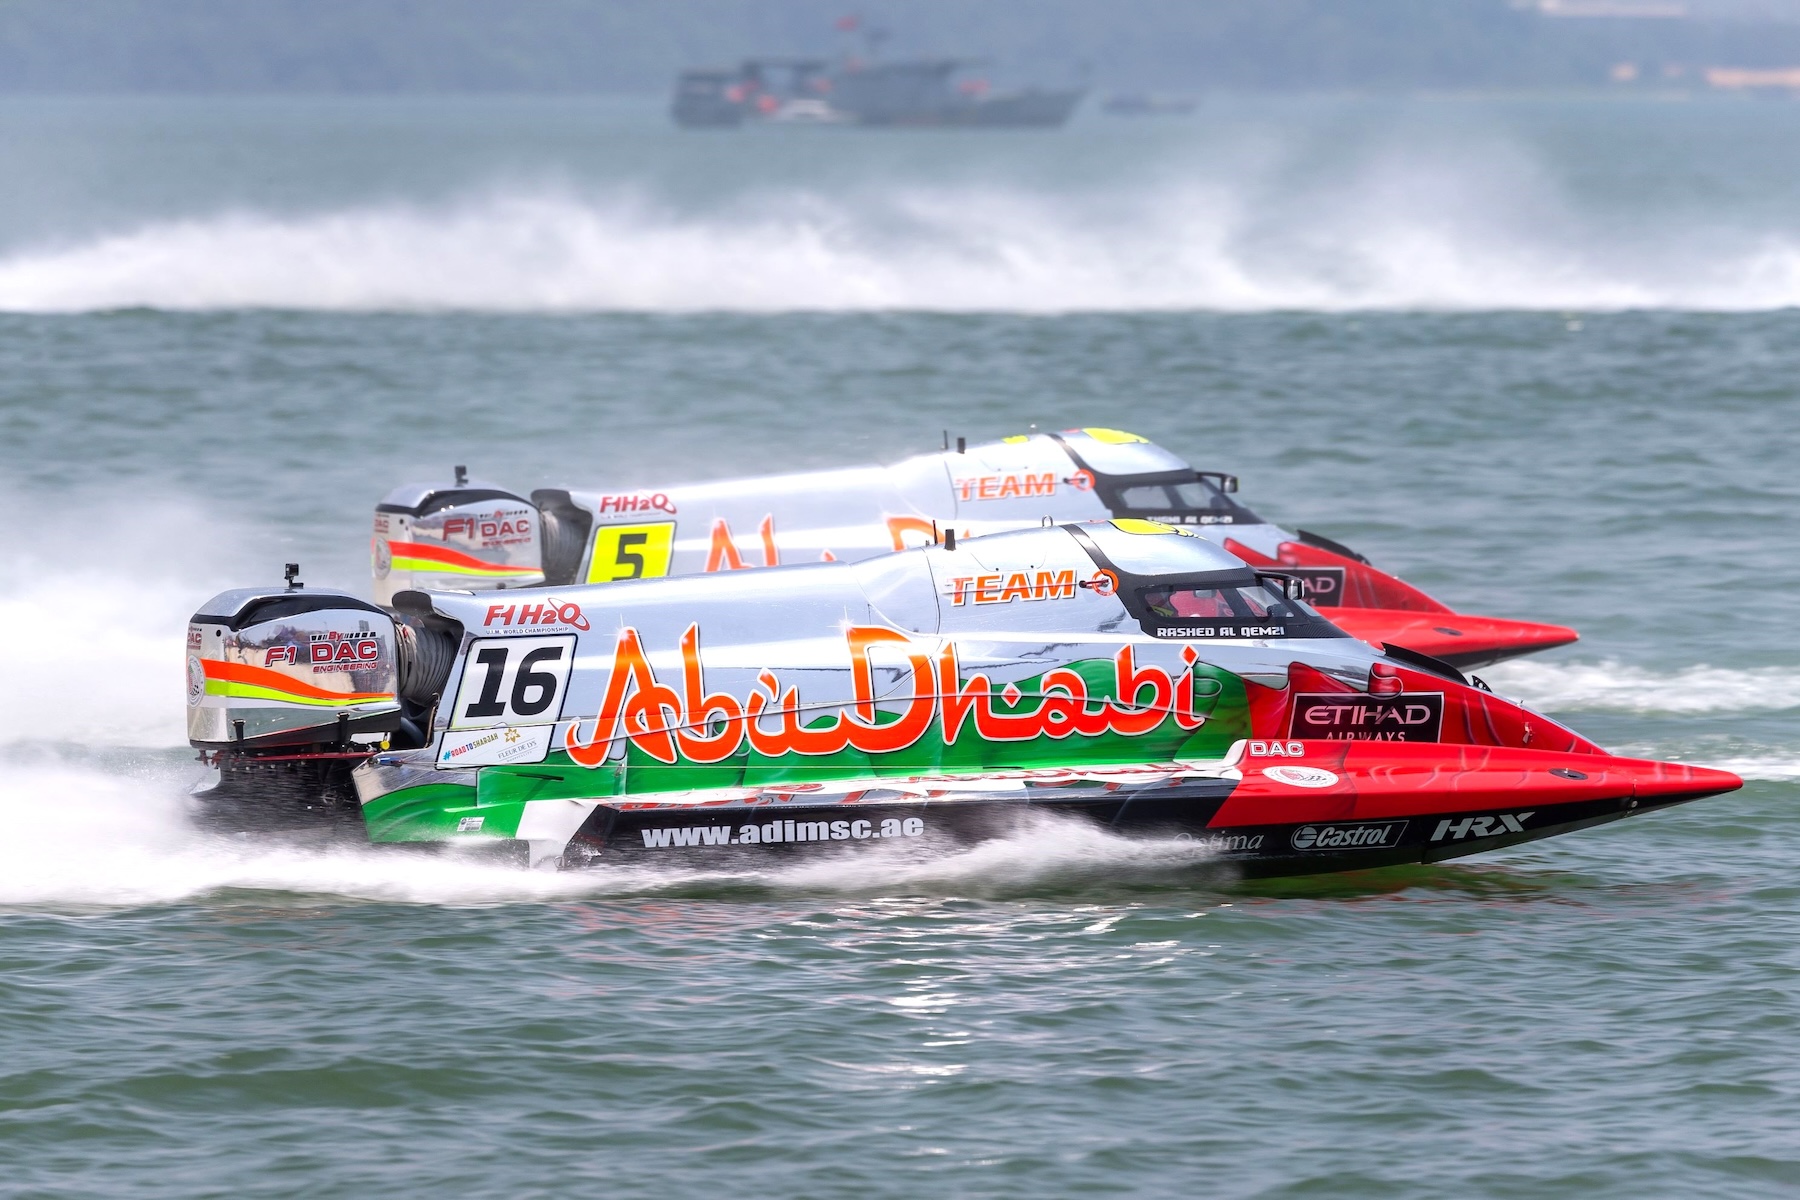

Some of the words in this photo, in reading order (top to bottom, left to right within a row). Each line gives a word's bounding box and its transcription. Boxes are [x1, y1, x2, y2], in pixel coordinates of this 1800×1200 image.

[955, 473, 1055, 500] TEAM
[443, 518, 475, 541] F1
[480, 518, 530, 538] DAC
[611, 533, 648, 581] 5
[948, 570, 1076, 606] TEAM
[525, 626, 569, 634] CHAMPIONSHIP
[1157, 627, 1215, 637] RASHED
[1220, 627, 1236, 636] AL
[1241, 626, 1285, 637] QEMZI
[264, 645, 298, 667] F1
[310, 640, 378, 663] DAC
[313, 661, 377, 674] ENGINEERING
[465, 646, 563, 718] 16
[565, 621, 848, 768] Abu
[843, 625, 1206, 754] Dhabi
[1305, 705, 1431, 725] ETIHAD
[498, 748, 517, 759] FLEUR
[1250, 742, 1304, 757] DAC
[641, 817, 924, 848] www.adimsc.ae
[1316, 825, 1393, 847] Castrol
[1430, 812, 1536, 841] HRX
